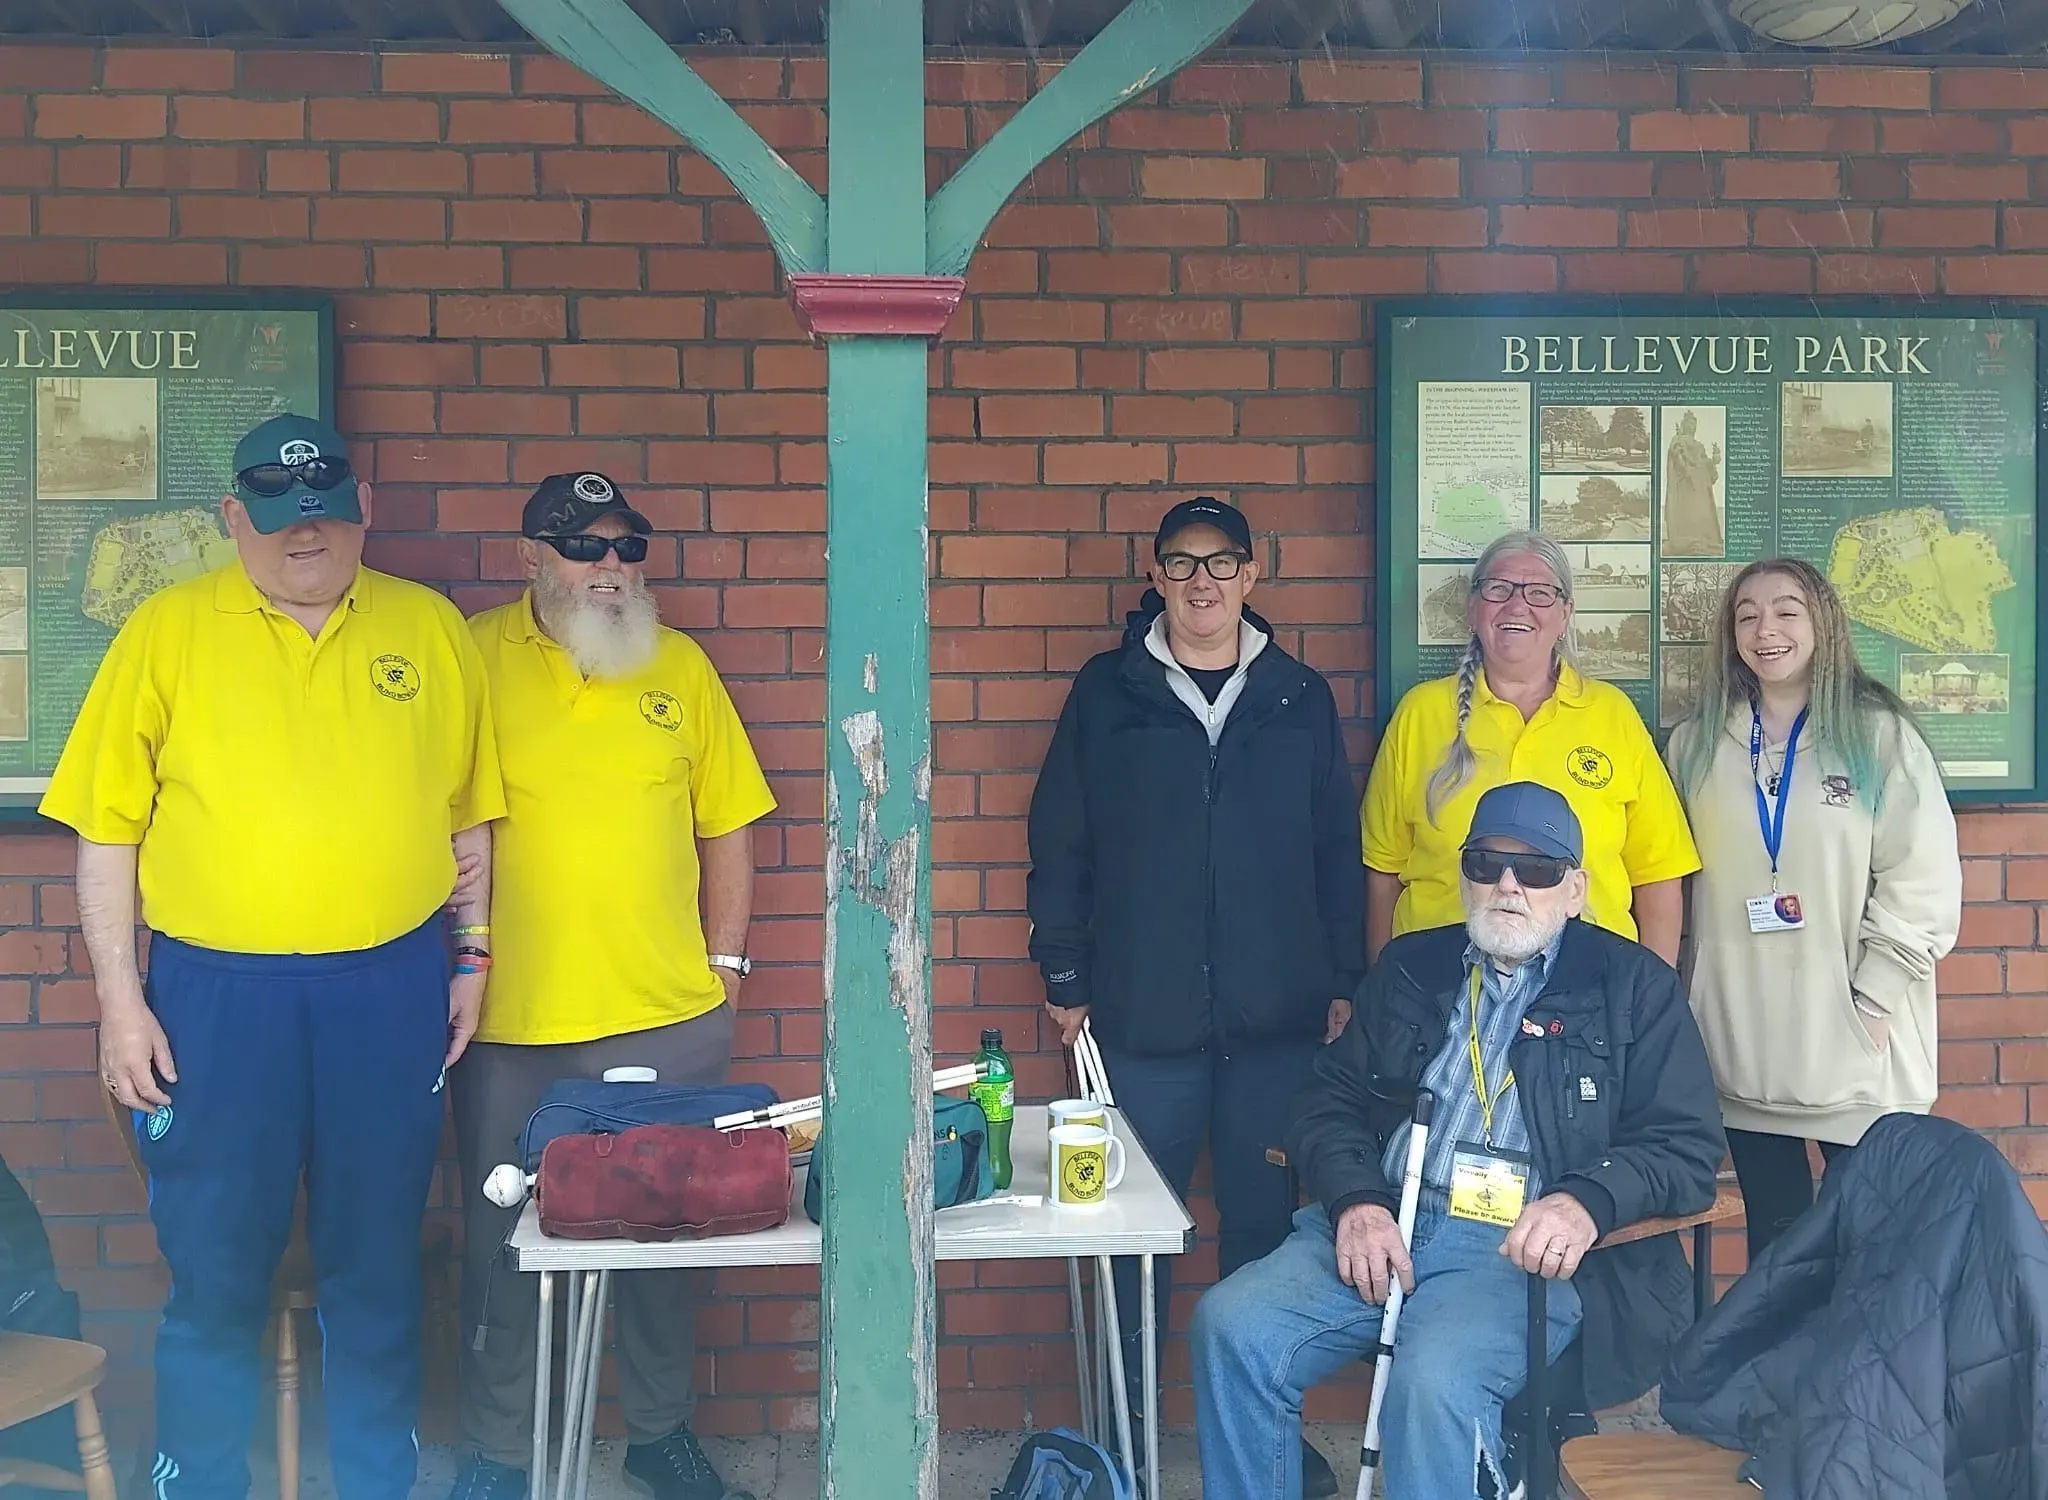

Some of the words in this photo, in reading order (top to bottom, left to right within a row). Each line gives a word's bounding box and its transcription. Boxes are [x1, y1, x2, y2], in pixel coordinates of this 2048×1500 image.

[0, 329, 200, 369] LEVUE
[1501, 335, 1774, 375] BELLEVUE
[1794, 335, 1932, 375] PARK
[1454, 1206, 1479, 1217] Please
